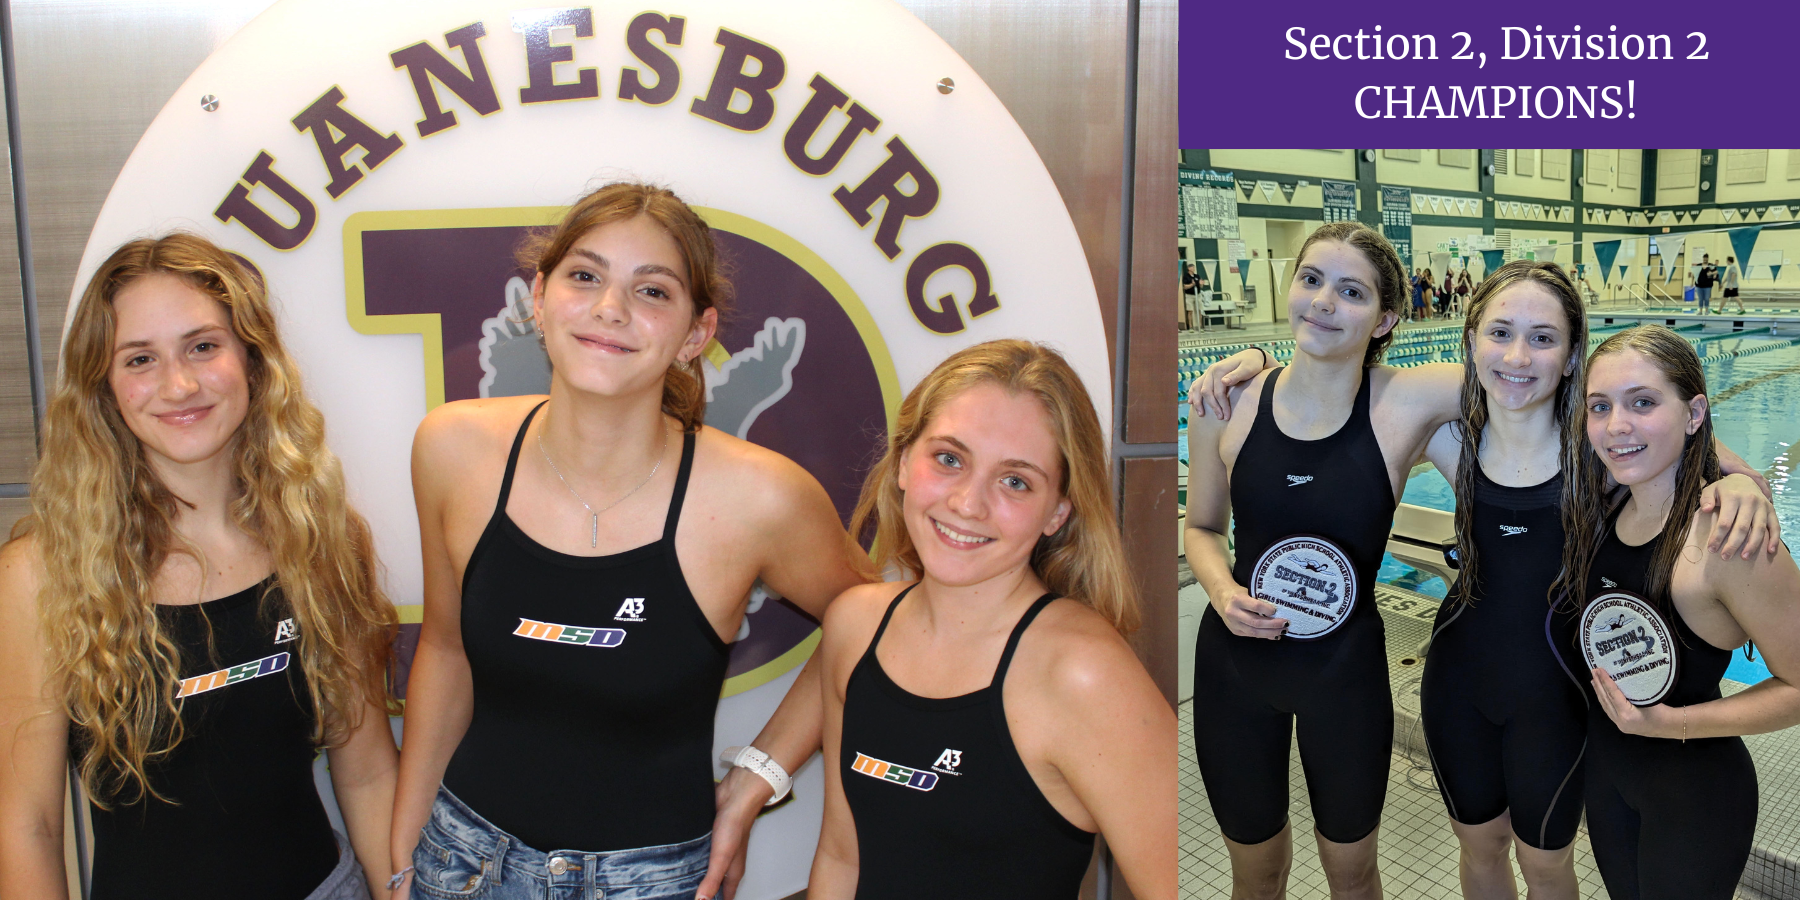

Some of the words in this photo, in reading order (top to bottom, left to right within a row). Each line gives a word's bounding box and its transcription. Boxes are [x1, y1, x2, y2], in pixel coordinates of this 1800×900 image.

[213, 5, 1001, 336] UANESBURG
[1180, 171, 1204, 180] DIVING
[1205, 174, 1234, 183] RECORDS
[1286, 474, 1314, 482] speedo
[1499, 524, 1528, 533] speedo
[1268, 550, 1283, 564] STATE
[1281, 543, 1301, 554] PUBLIC
[1315, 545, 1335, 560] SCHOOL
[1260, 561, 1271, 576] YORK
[1334, 558, 1350, 584] ATHLETIC
[1274, 565, 1327, 593] SECTION
[1326, 582, 1337, 597] 2
[614, 597, 645, 619] A3
[1257, 592, 1276, 603] GIRLS
[1275, 598, 1309, 614] SWIMMING
[1308, 607, 1315, 616] &
[1314, 610, 1337, 623] DIVING
[1336, 583, 1351, 616] ASSOCIATION
[274, 618, 295, 641] A3
[1604, 600, 1623, 609] SCHOOL
[1624, 600, 1648, 619] ATHLETIC
[1647, 616, 1668, 654] ASSOCIATION
[1595, 629, 1640, 657] SECTION
[1637, 626, 1650, 641] 2
[1616, 665, 1646, 681] SWIMMING
[1649, 657, 1670, 670] DIVING
[933, 748, 963, 770] A3
